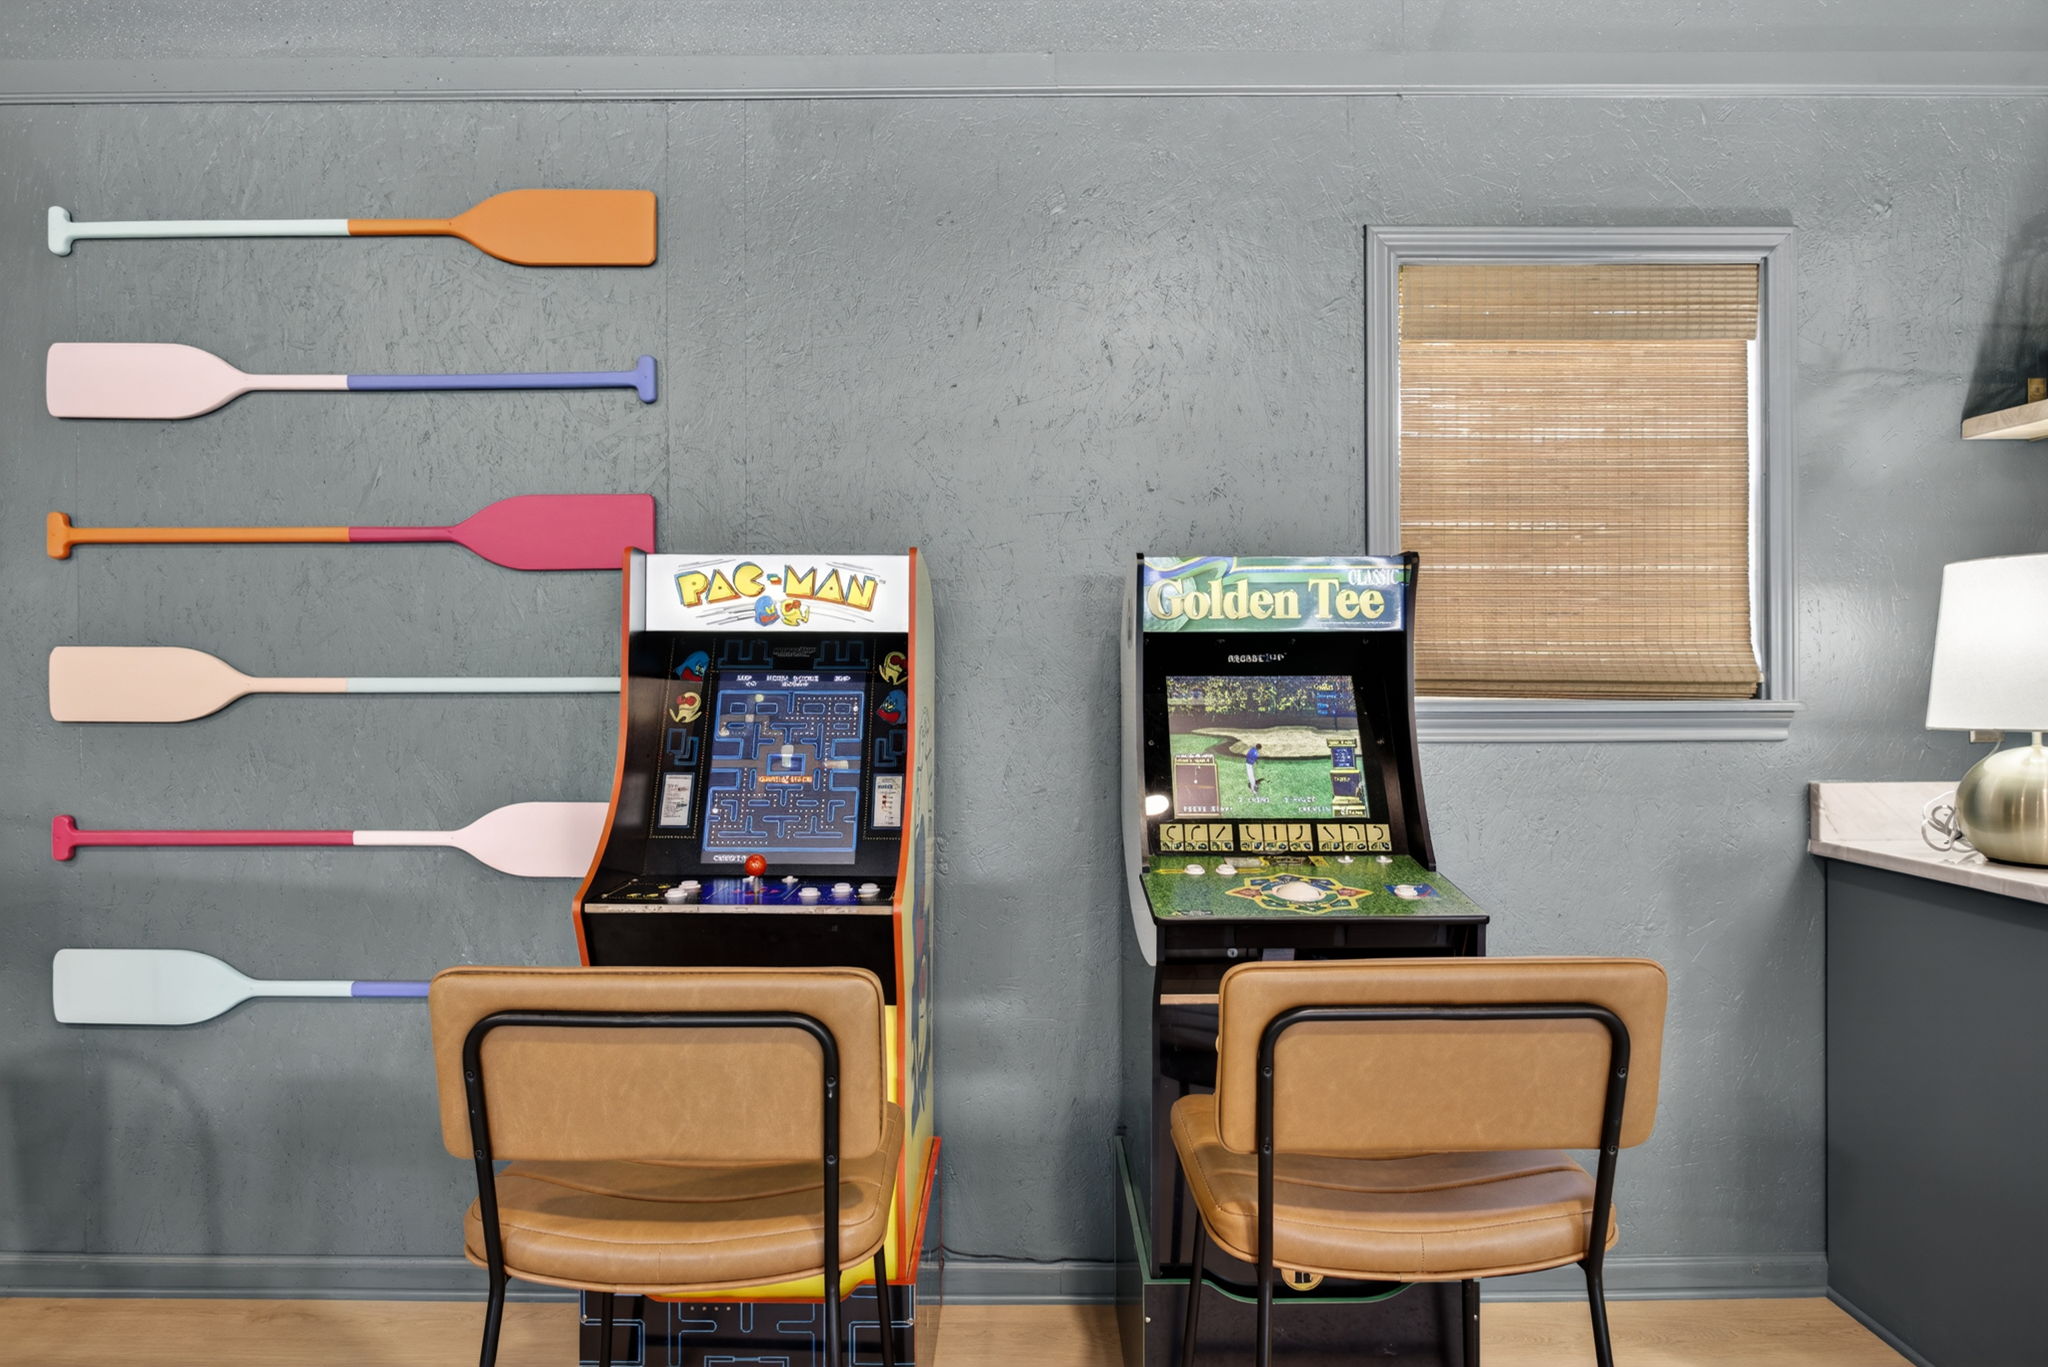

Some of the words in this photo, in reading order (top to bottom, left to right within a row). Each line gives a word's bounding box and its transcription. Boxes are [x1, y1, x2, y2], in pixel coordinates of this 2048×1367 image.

[674, 561, 878, 612] PAC-MAN
[1348, 568, 1400, 586] CLASSIC
[1147, 578, 1302, 620] Golden
[1308, 578, 1385, 619] Tee
